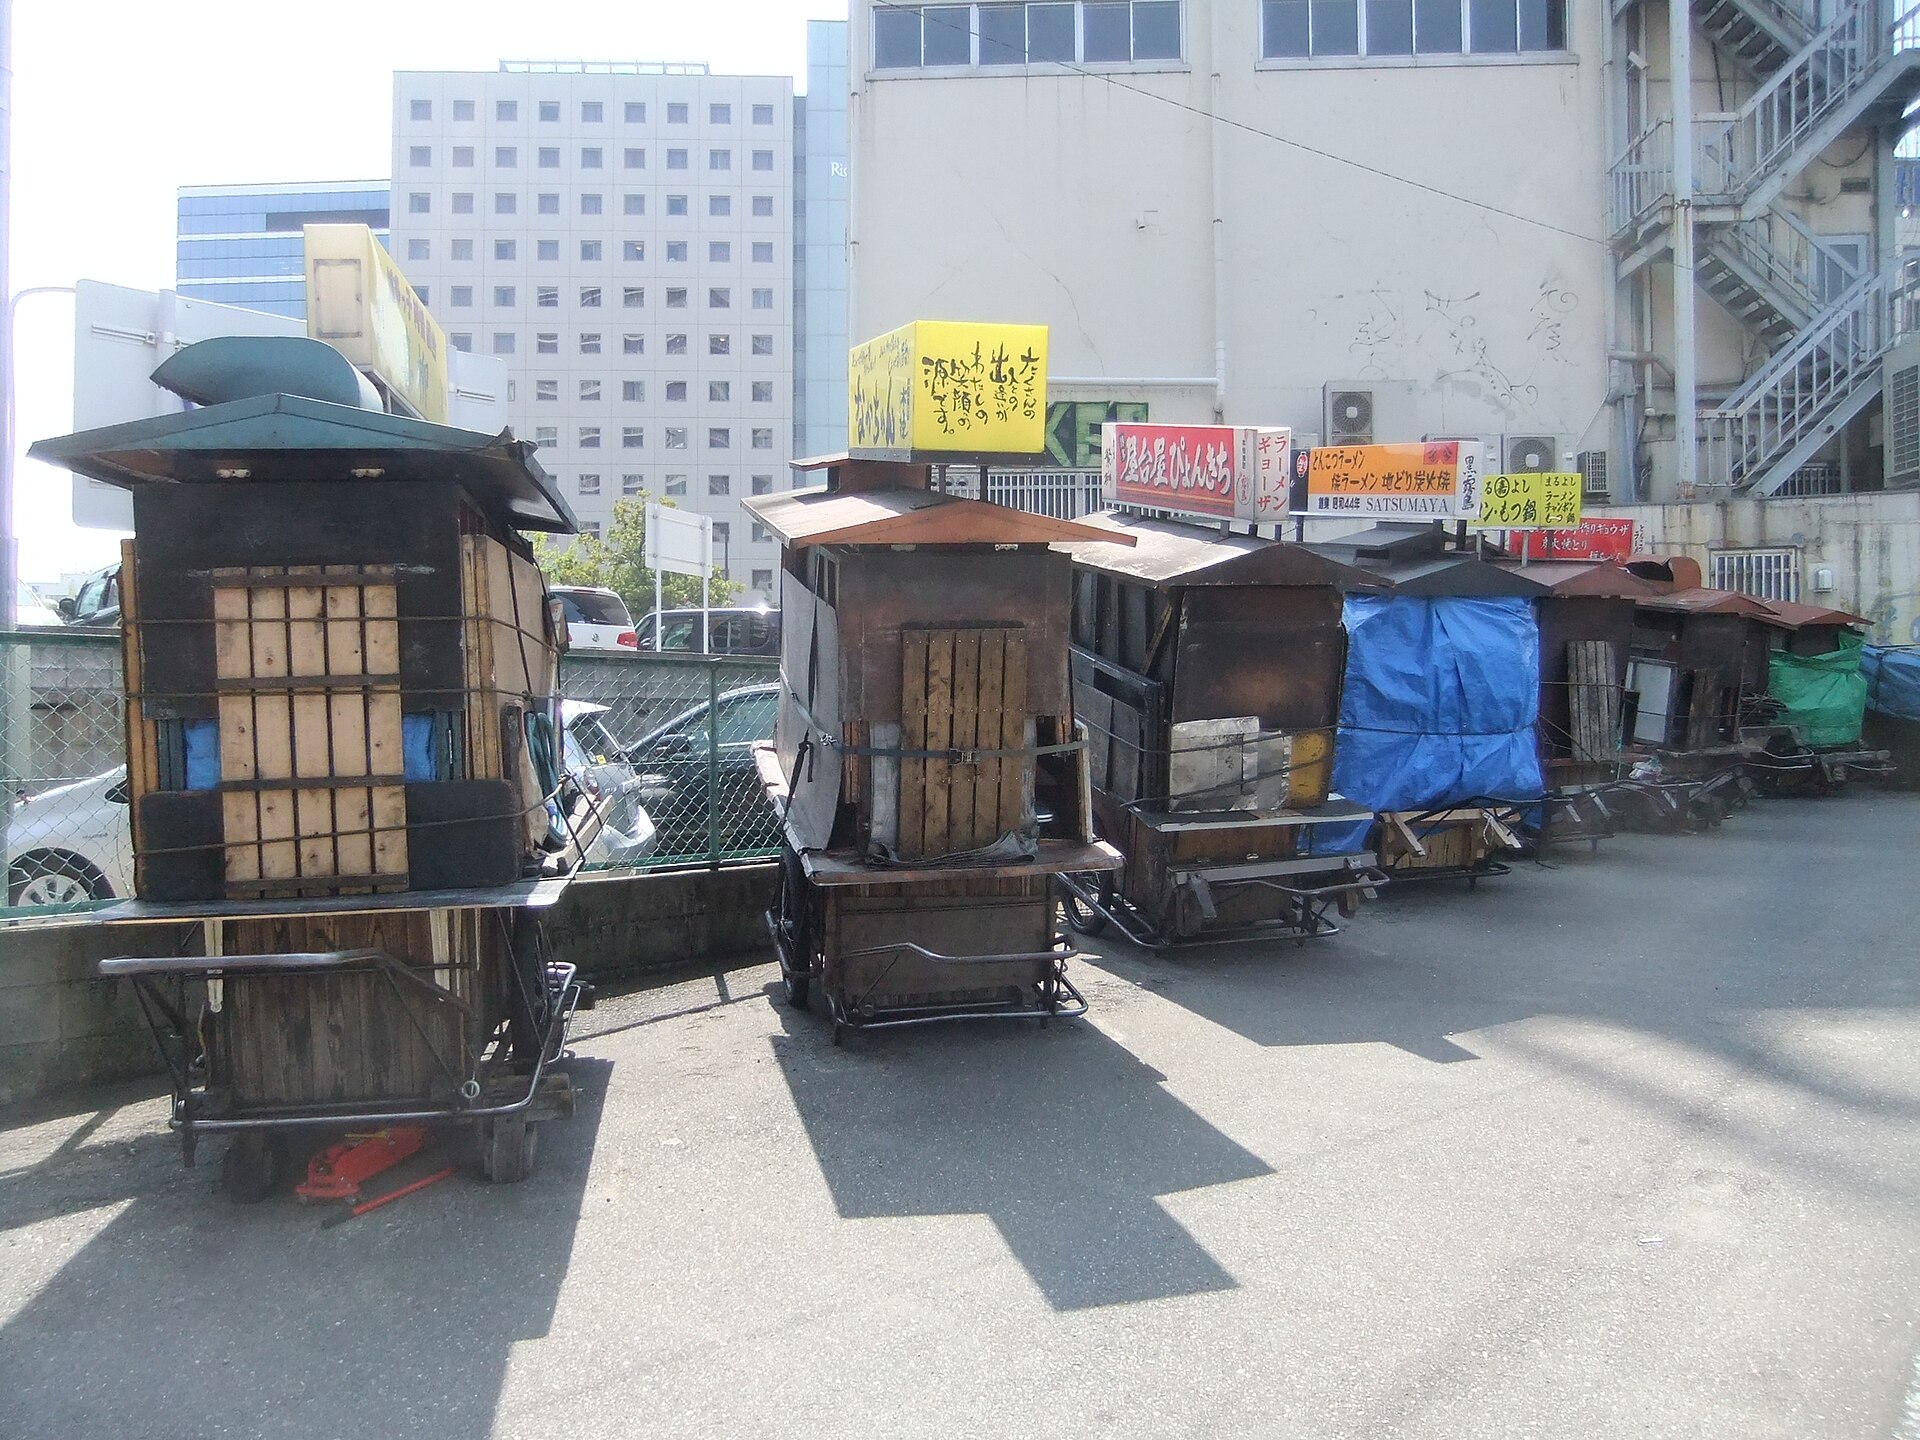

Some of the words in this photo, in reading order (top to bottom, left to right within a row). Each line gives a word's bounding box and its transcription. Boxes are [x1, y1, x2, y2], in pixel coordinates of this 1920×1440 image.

[1312, 450, 1365, 471] とんこつラーメン
[1257, 437, 1271, 512] ギョーザ
[1273, 436, 1287, 511] ラーメン
[1545, 476, 1576, 486] まるよし
[1366, 497, 1448, 512] SATSUMAYA
[1545, 491, 1576, 501] ラーメン
[1479, 499, 1537, 523] ン・もつ鍋
